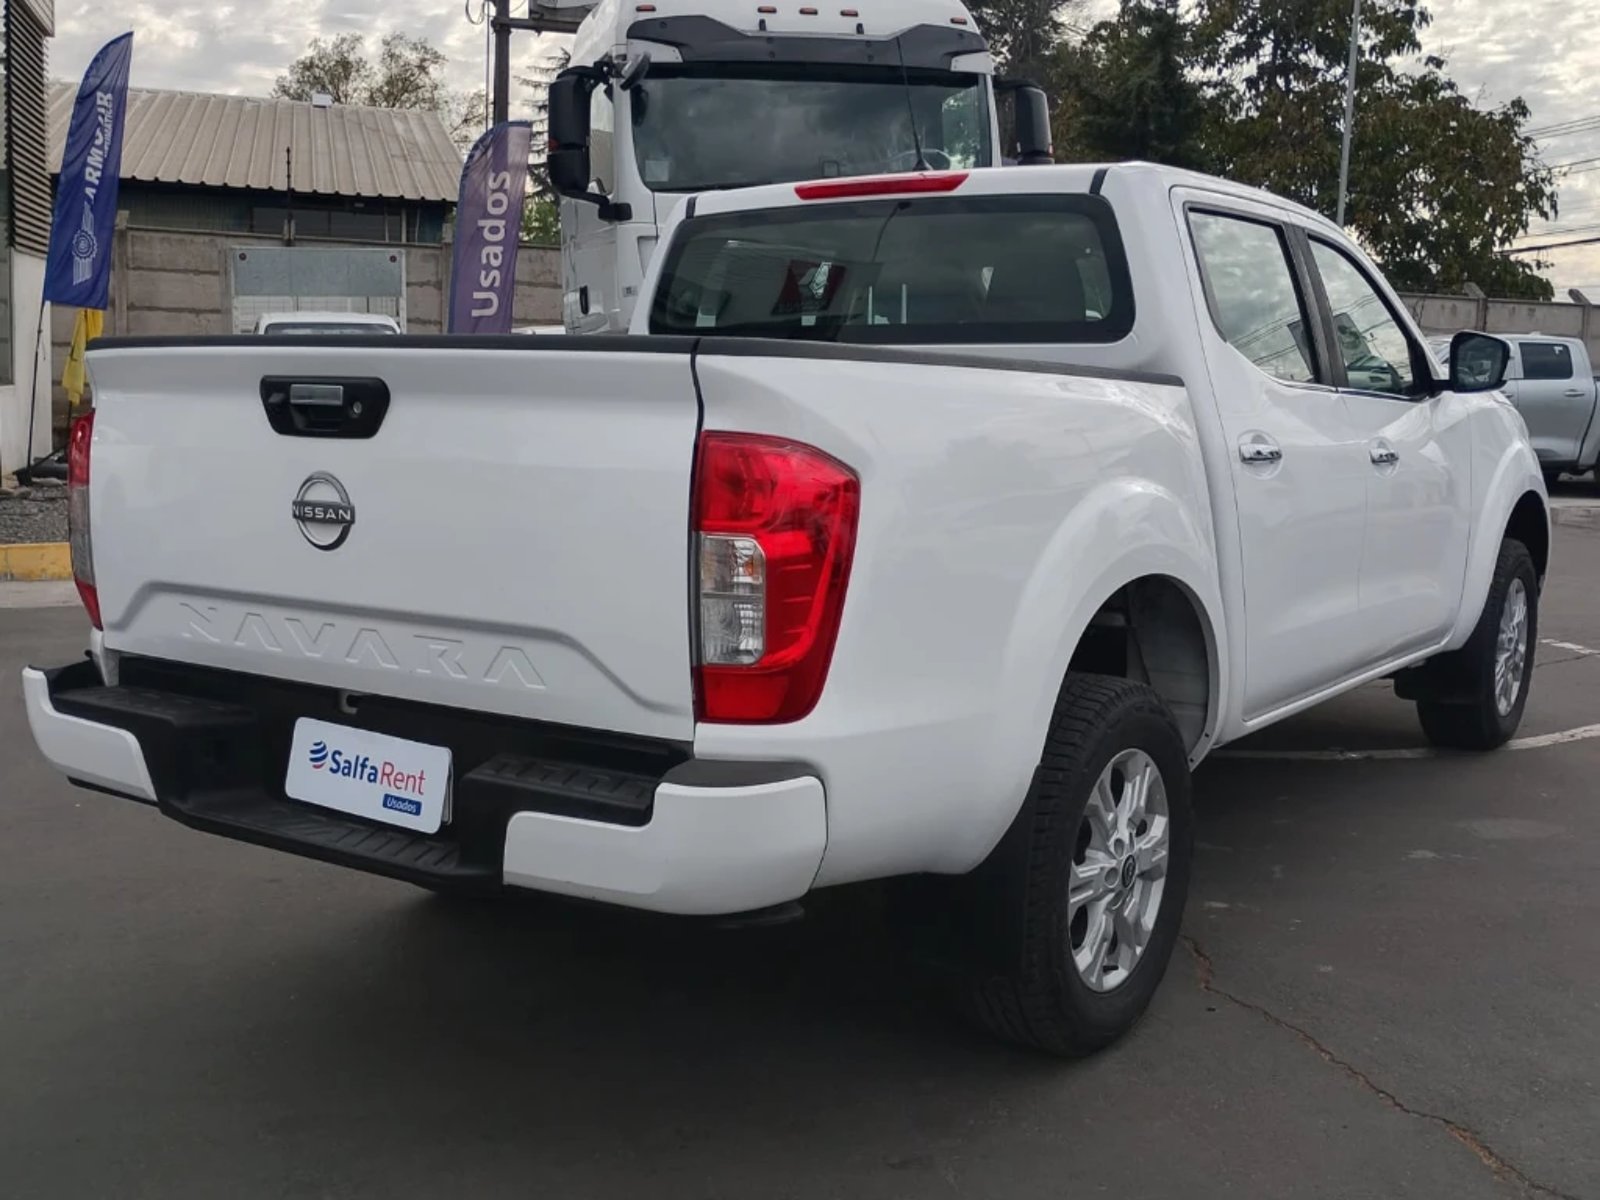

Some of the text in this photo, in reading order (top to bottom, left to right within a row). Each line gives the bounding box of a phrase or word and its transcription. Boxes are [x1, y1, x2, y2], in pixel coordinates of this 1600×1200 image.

[471, 170, 511, 317] Usados
[292, 505, 351, 521] NISSAN
[179, 602, 546, 690] NAVARA
[386, 796, 417, 813] Usados
